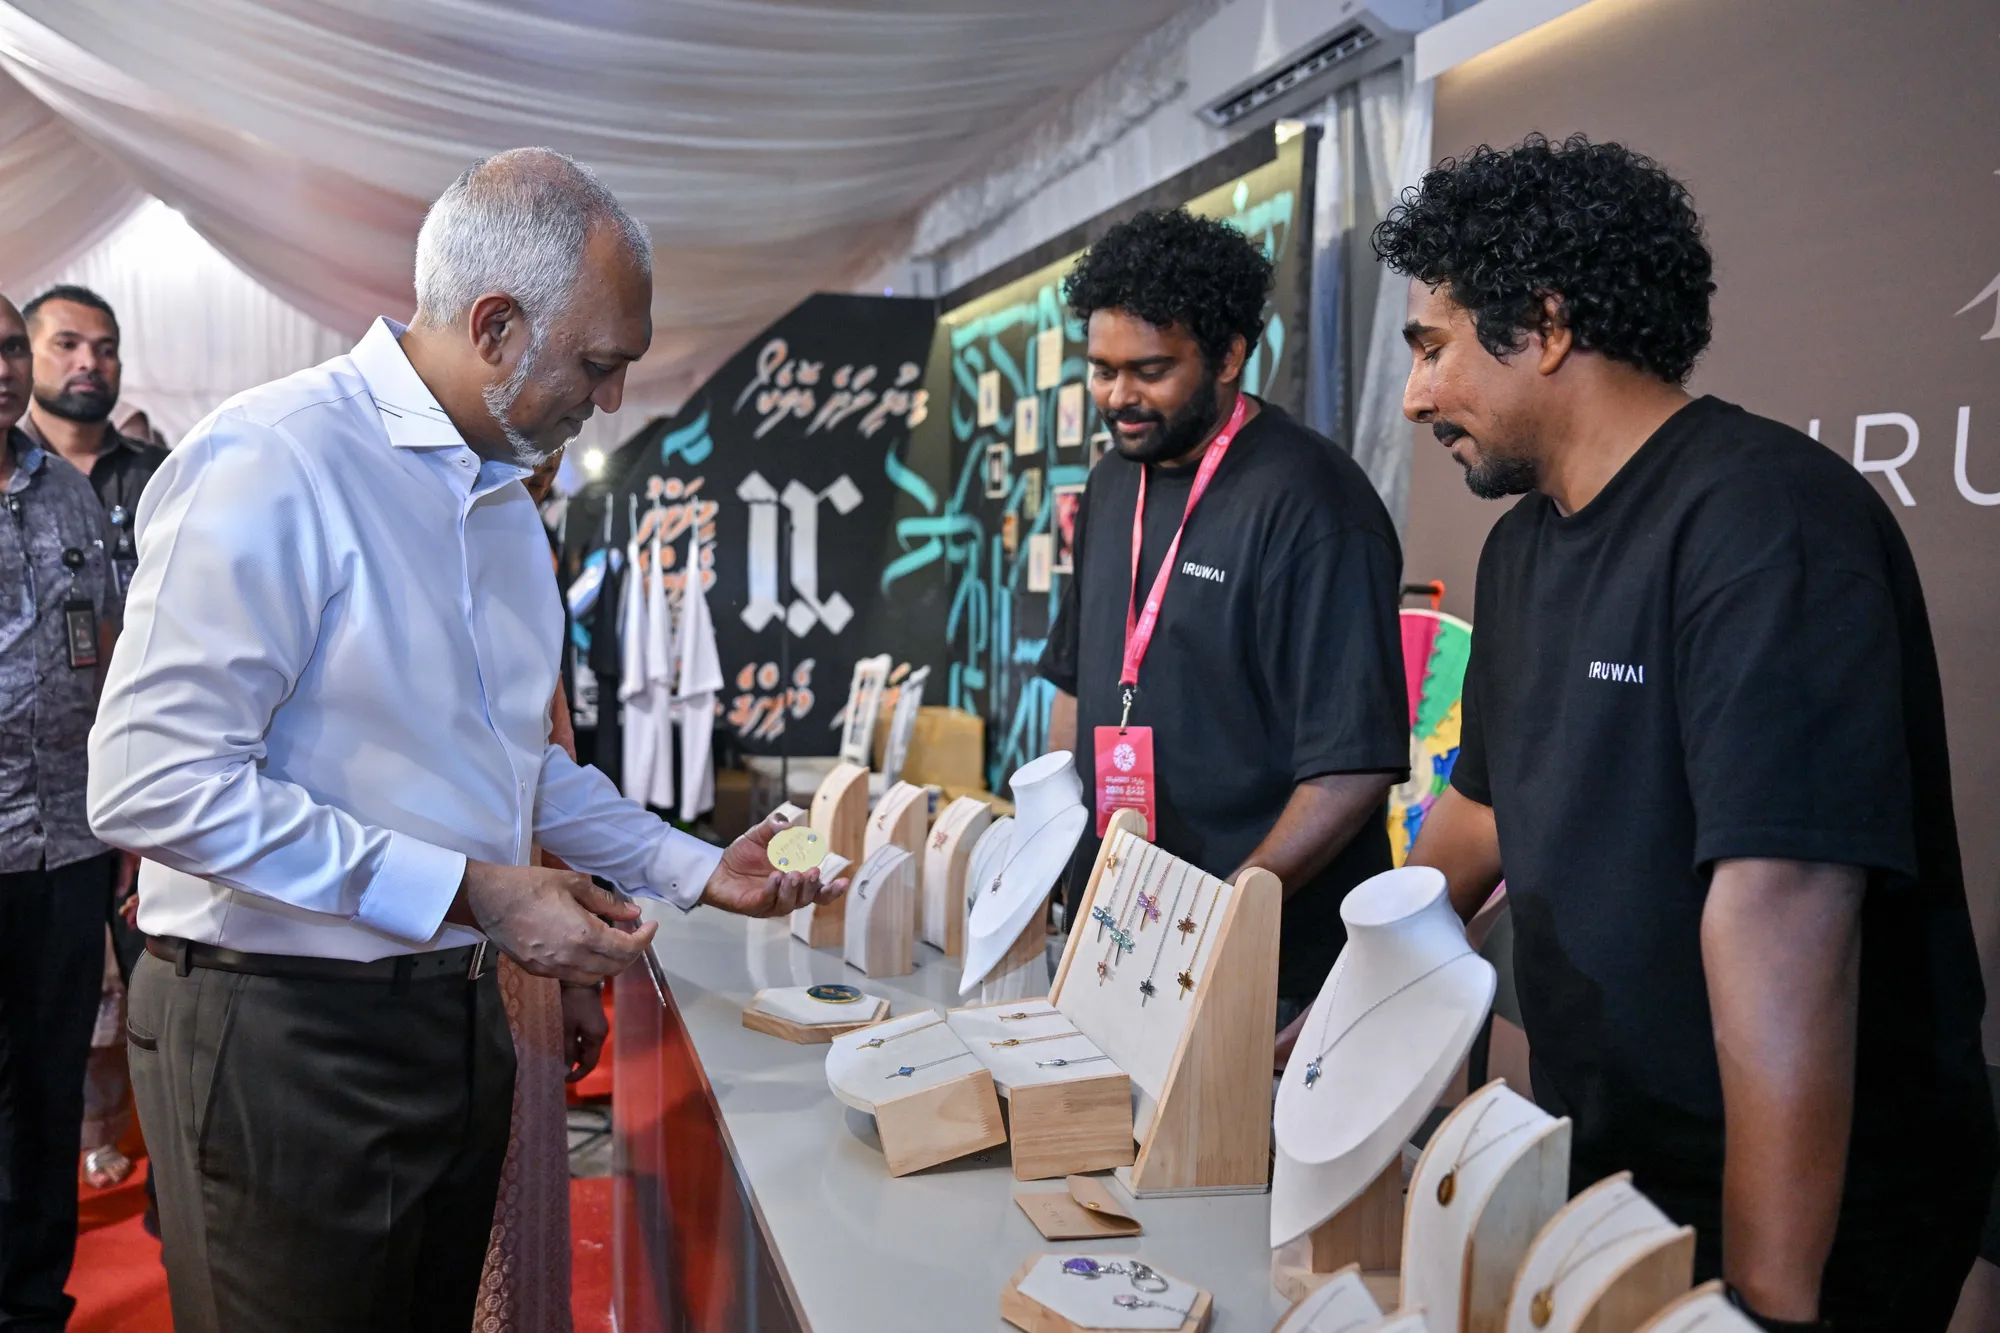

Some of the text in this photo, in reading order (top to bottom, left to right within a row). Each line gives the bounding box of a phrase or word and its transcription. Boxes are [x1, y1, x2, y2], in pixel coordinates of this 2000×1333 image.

[1808, 405, 2000, 506] RU
[1181, 561, 1226, 583] IRUWAI
[1588, 660, 1644, 684] IRUWAI
